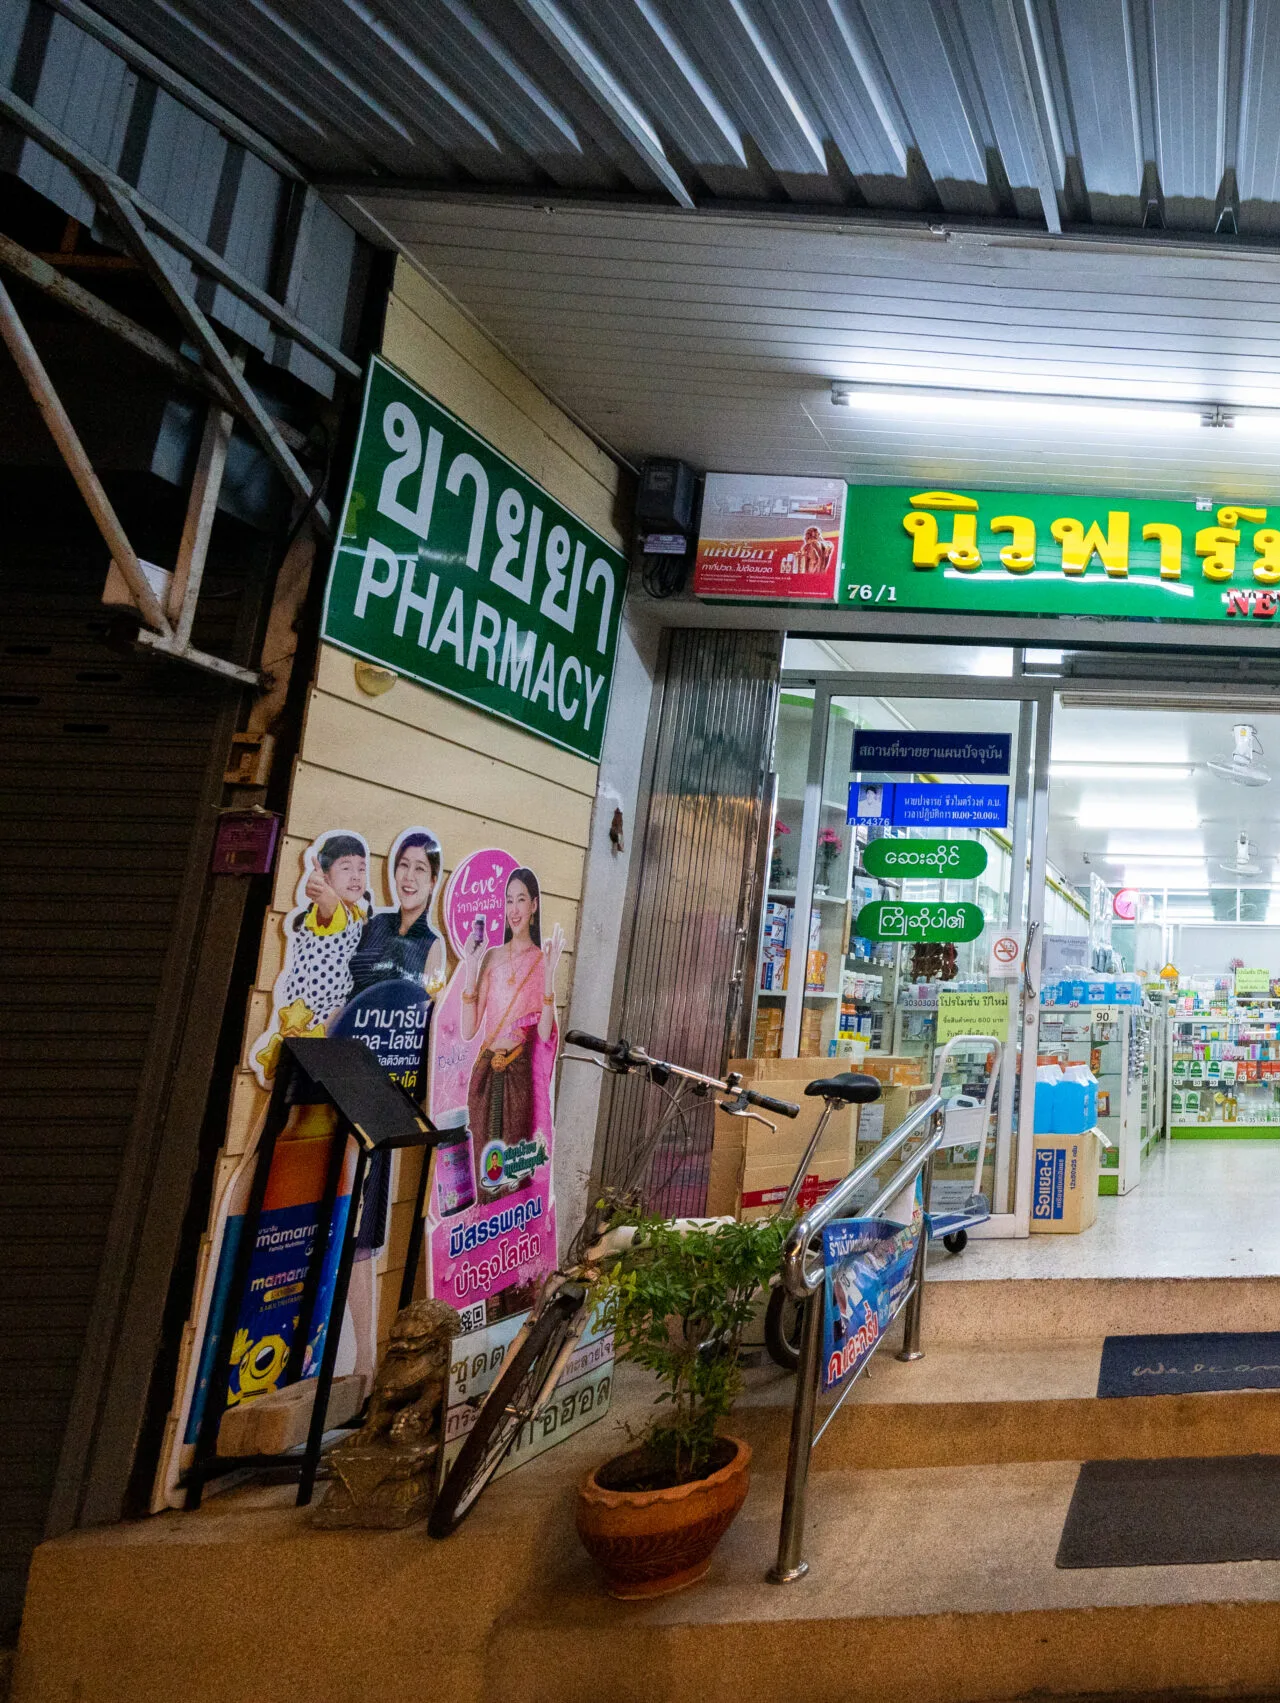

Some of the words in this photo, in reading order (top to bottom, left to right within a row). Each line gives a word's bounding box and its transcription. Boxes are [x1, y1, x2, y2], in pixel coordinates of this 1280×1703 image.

[376, 401, 616, 655] ขายยา
[846, 584, 898, 603] 76/1
[353, 537, 605, 732] PHARMACY
[859, 740, 1003, 765] สถานที่ขายยาแผนปัจจุบัน
[885, 845, 960, 874] ဆေးဆိုင်
[460, 865, 496, 896] Love
[878, 906, 966, 937] ကြိုဆိုပါ၏
[939, 994, 981, 1007] โปรโมชั่น
[982, 995, 1008, 1007] ปีใหม่
[353, 1003, 428, 1029] มามารีน
[352, 1029, 424, 1051] วล-ไลซีน
[255, 1223, 320, 1249] mamarin
[449, 1196, 544, 1259] มีสรรพคุณ
[454, 1234, 542, 1299] บำรุงโลหิต
